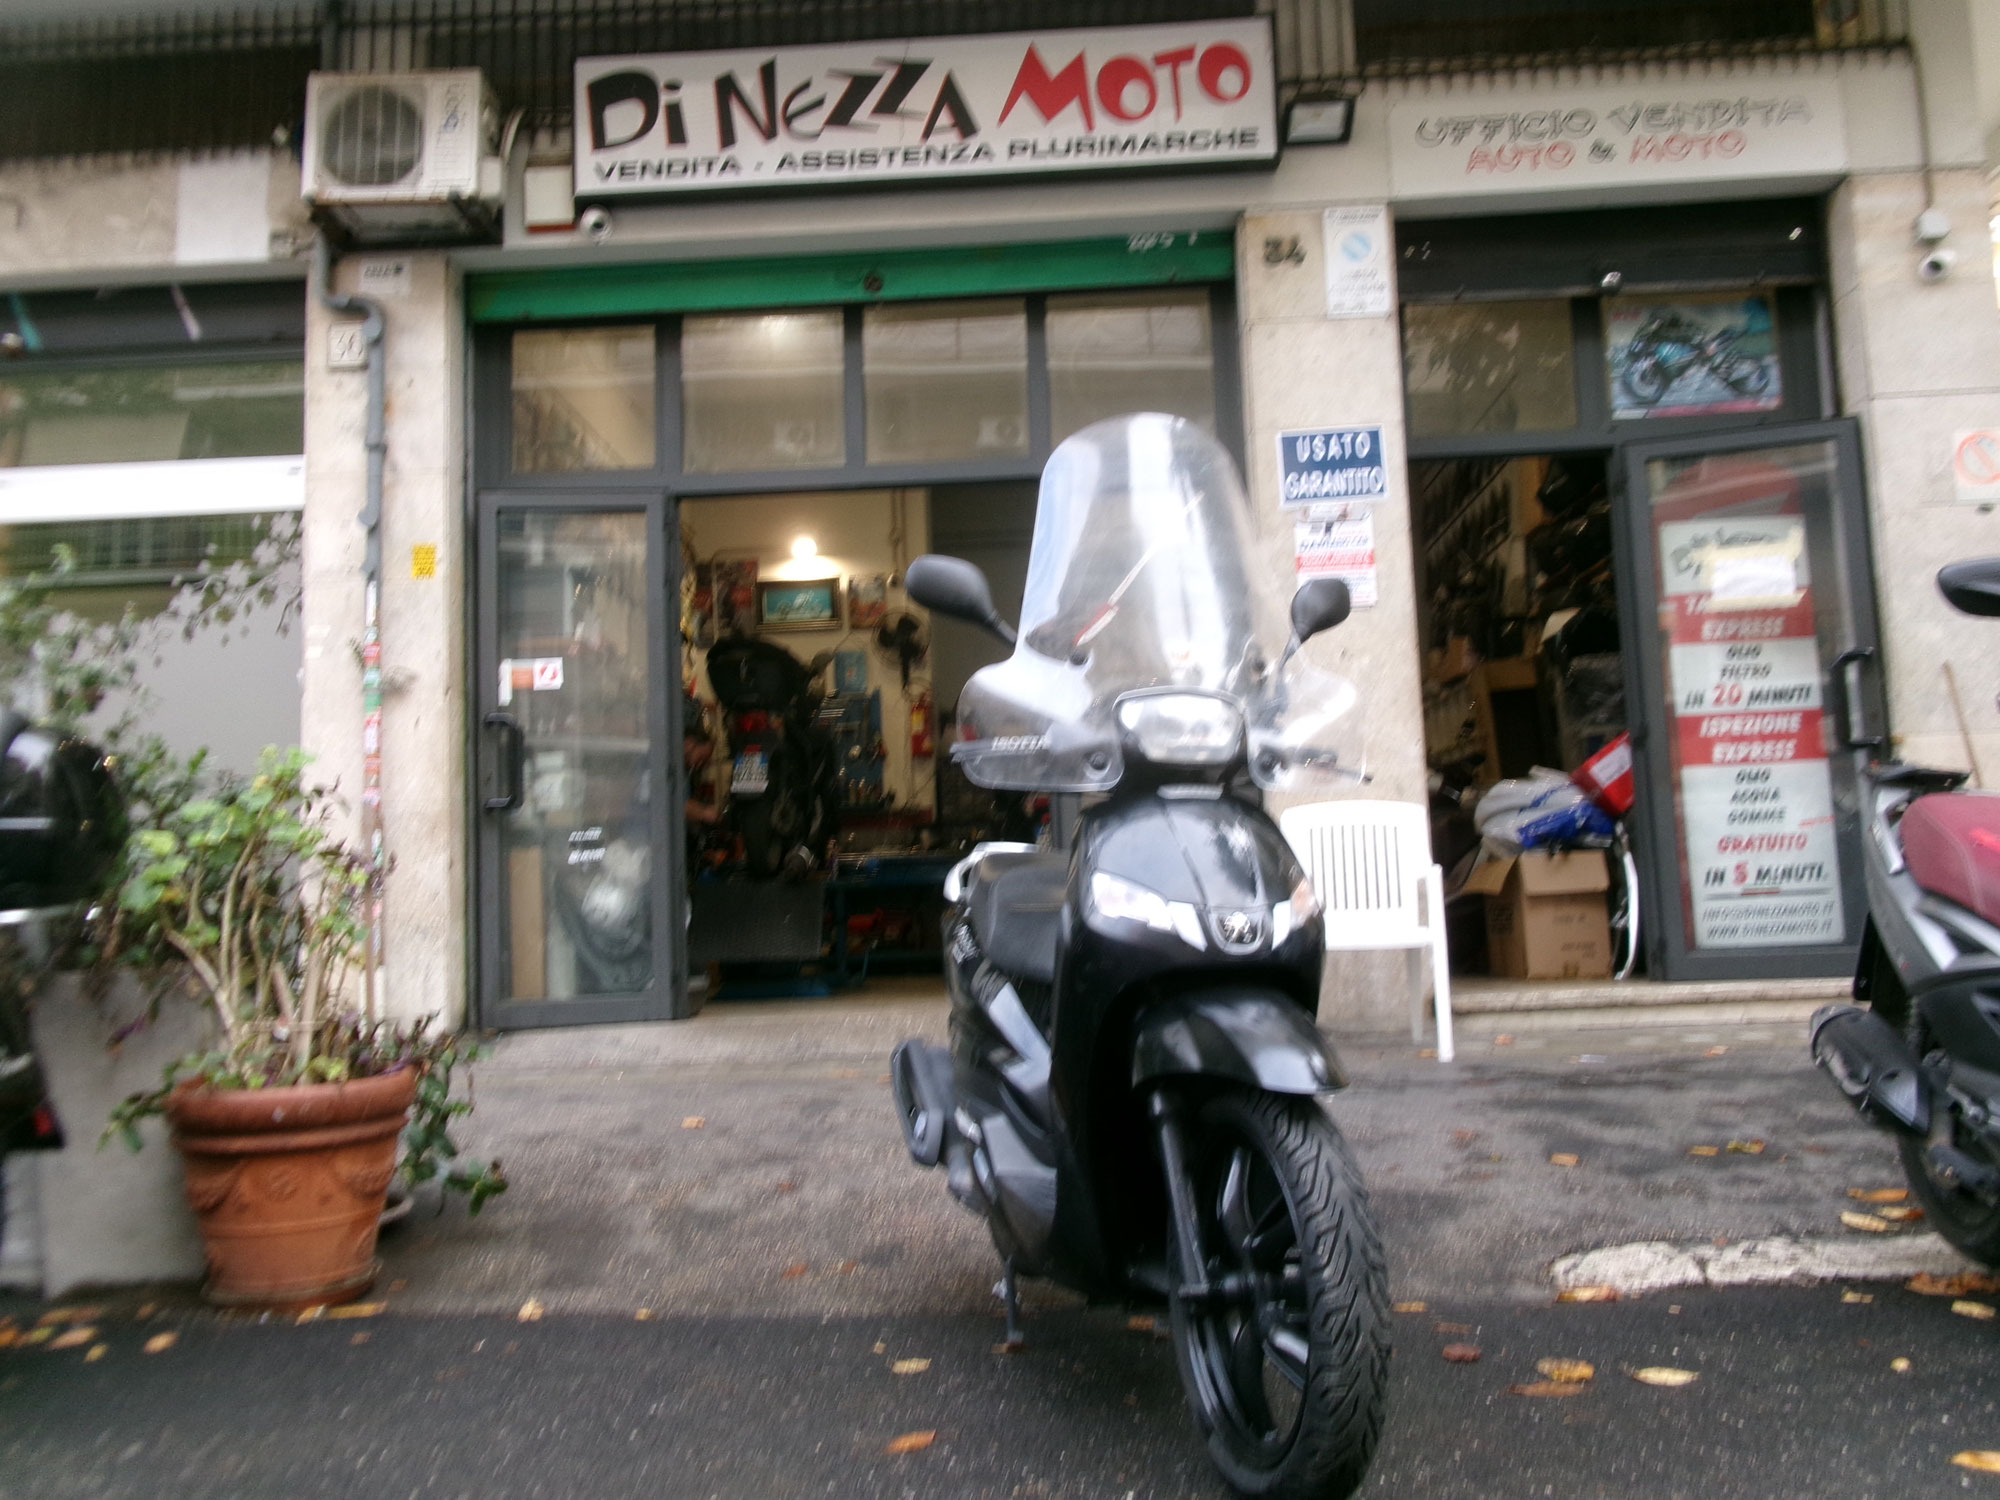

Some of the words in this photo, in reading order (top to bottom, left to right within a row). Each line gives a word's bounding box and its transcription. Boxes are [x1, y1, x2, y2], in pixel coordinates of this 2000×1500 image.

[998, 39, 1254, 134] MOTO
[1414, 107, 1597, 148] UFFICIO
[1606, 94, 1814, 135] VENDITA
[595, 155, 741, 182] VENDITA
[775, 134, 996, 174] ASSISTENZA
[1007, 125, 1259, 162] PLURIMARCHE
[1464, 140, 1576, 175] AUTO
[1628, 130, 1748, 164] MOTO
[1295, 431, 1371, 463] USATO
[1284, 465, 1385, 499] GARANTITO
[1702, 616, 1785, 641] EXPRESS
[1725, 645, 1763, 660] OLIO
[1720, 663, 1773, 679] FILTRO
[1684, 690, 1707, 709] IN
[1711, 683, 1745, 707] 20
[1748, 684, 1812, 707] MINUTI
[1699, 712, 1803, 738] ISPEZIONE
[1711, 738, 1798, 764] EXPRESS
[1735, 768, 1771, 784] OLIO
[1729, 786, 1782, 804] ACQUA
[1726, 806, 1787, 825] GOMME
[1717, 833, 1808, 855] GRATUITO
[1703, 865, 1726, 887] IN
[1732, 862, 1749, 886] 5
